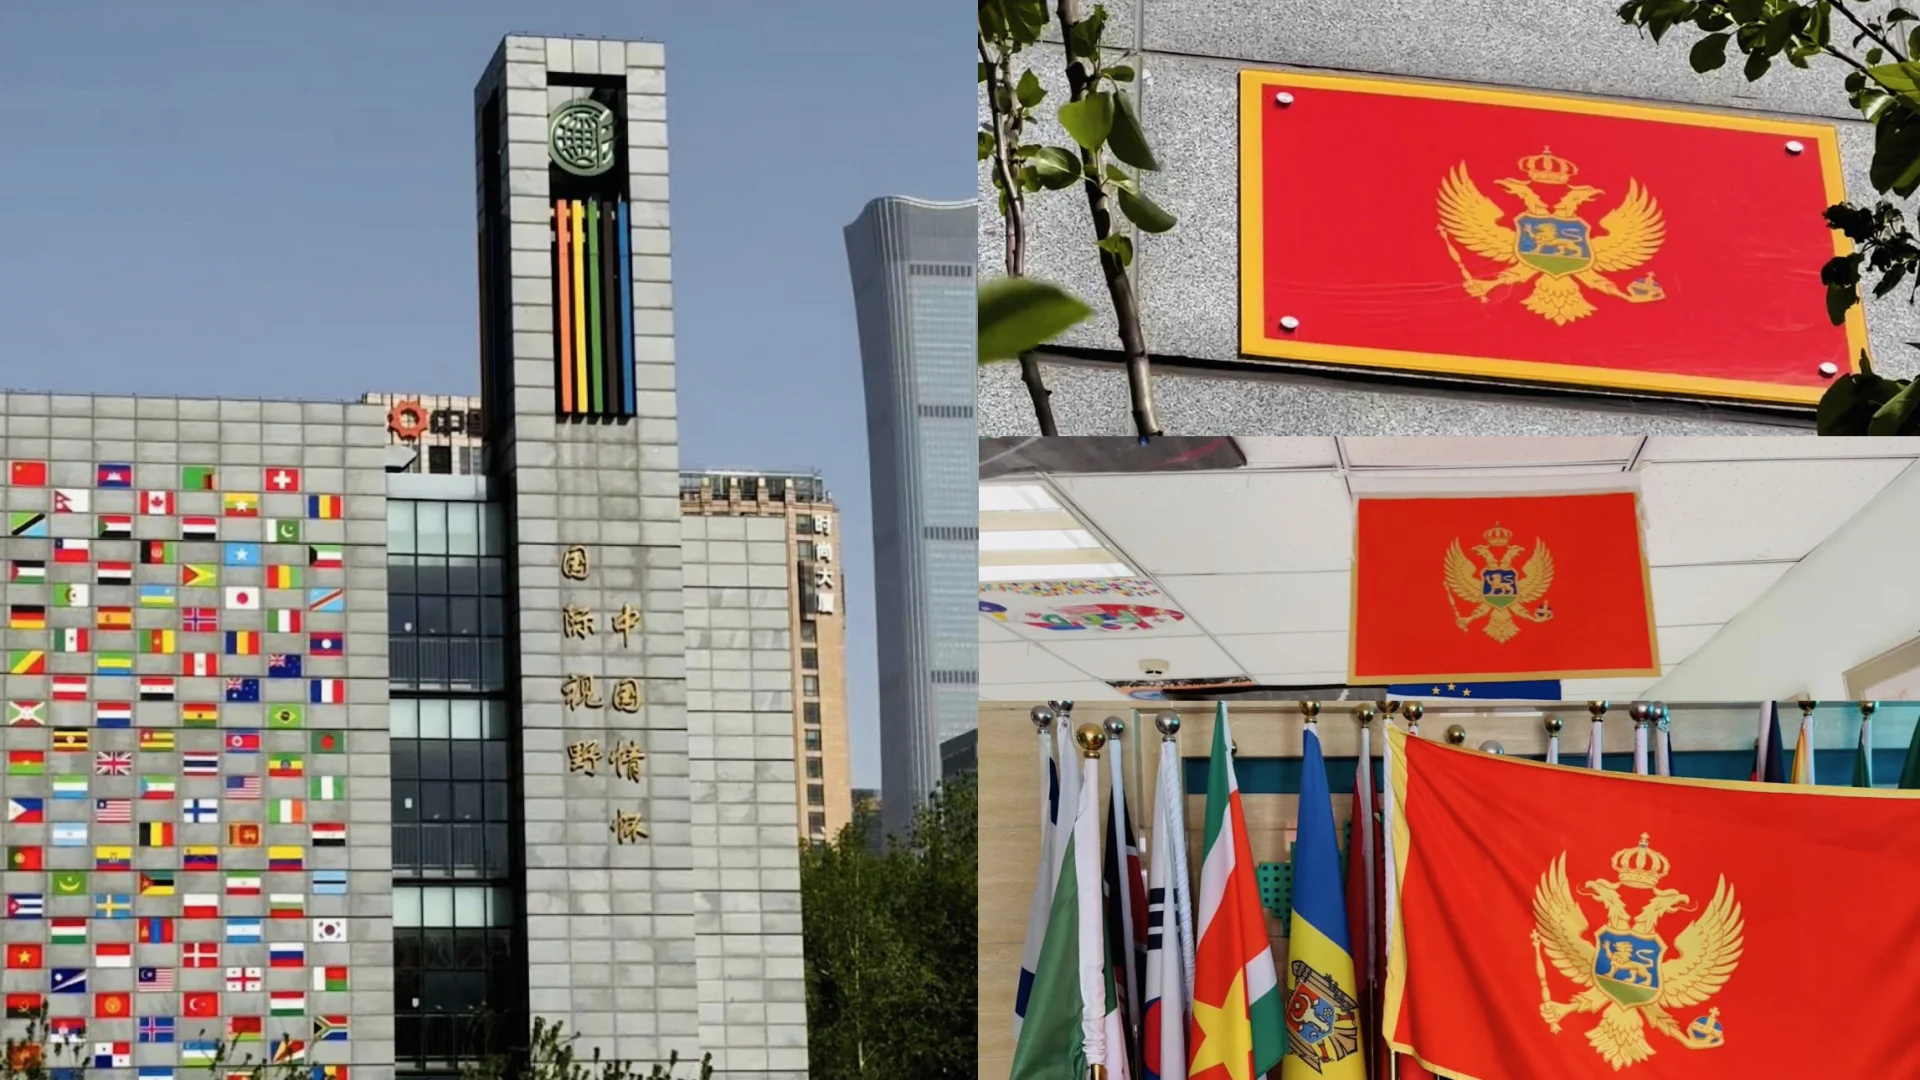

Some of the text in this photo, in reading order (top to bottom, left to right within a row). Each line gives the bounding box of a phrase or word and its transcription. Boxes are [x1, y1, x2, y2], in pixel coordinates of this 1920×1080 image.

[560, 544, 603, 777] 国际视野
[608, 601, 649, 846] 中国情怀
